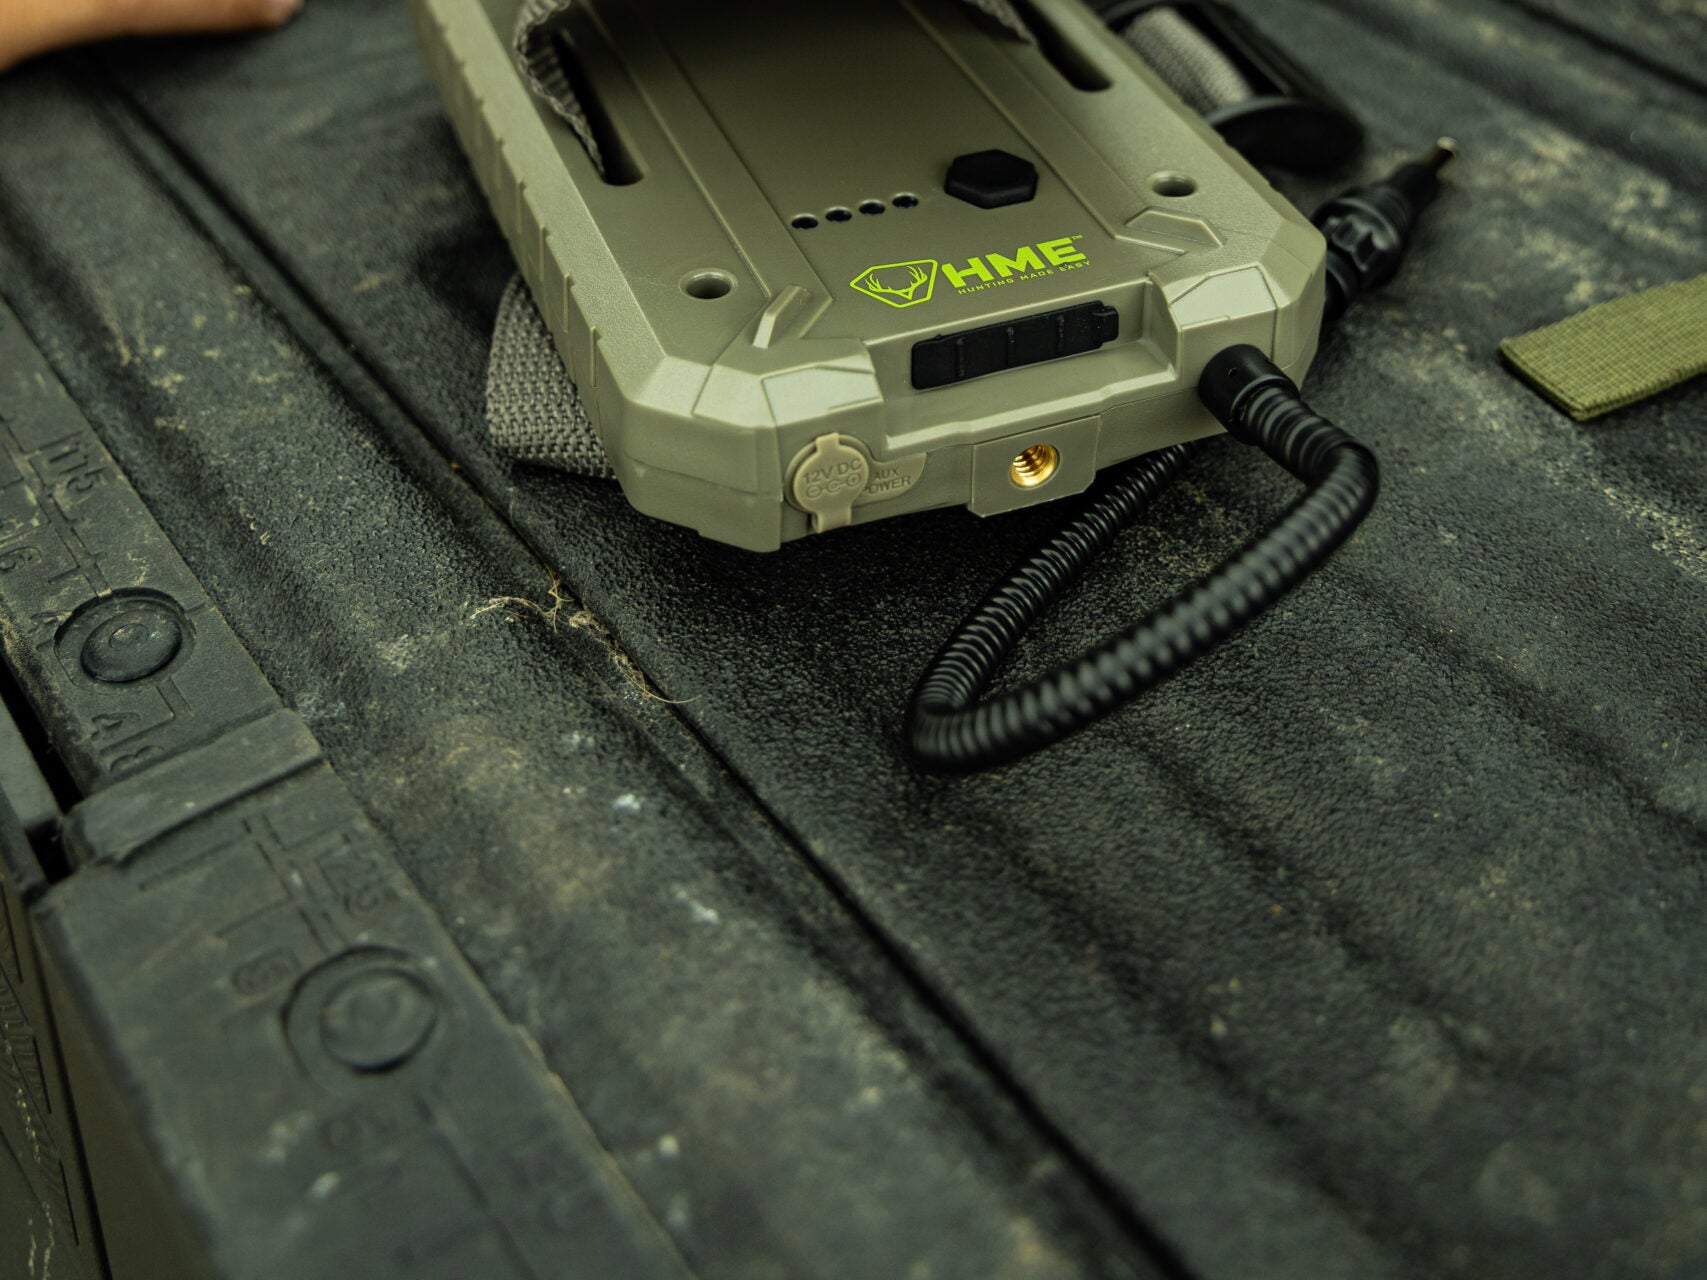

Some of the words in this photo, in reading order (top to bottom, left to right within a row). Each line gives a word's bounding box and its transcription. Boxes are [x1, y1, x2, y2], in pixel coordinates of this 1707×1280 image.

[941, 237, 1086, 288] HME
[958, 278, 1015, 295] HUNTING
[1020, 269, 1054, 281] MADE
[1059, 260, 1091, 272] EASY
[804, 466, 833, 484] 12V
[838, 459, 862, 475] DC
[873, 467, 900, 480] AUX
[863, 475, 912, 495] POWER
